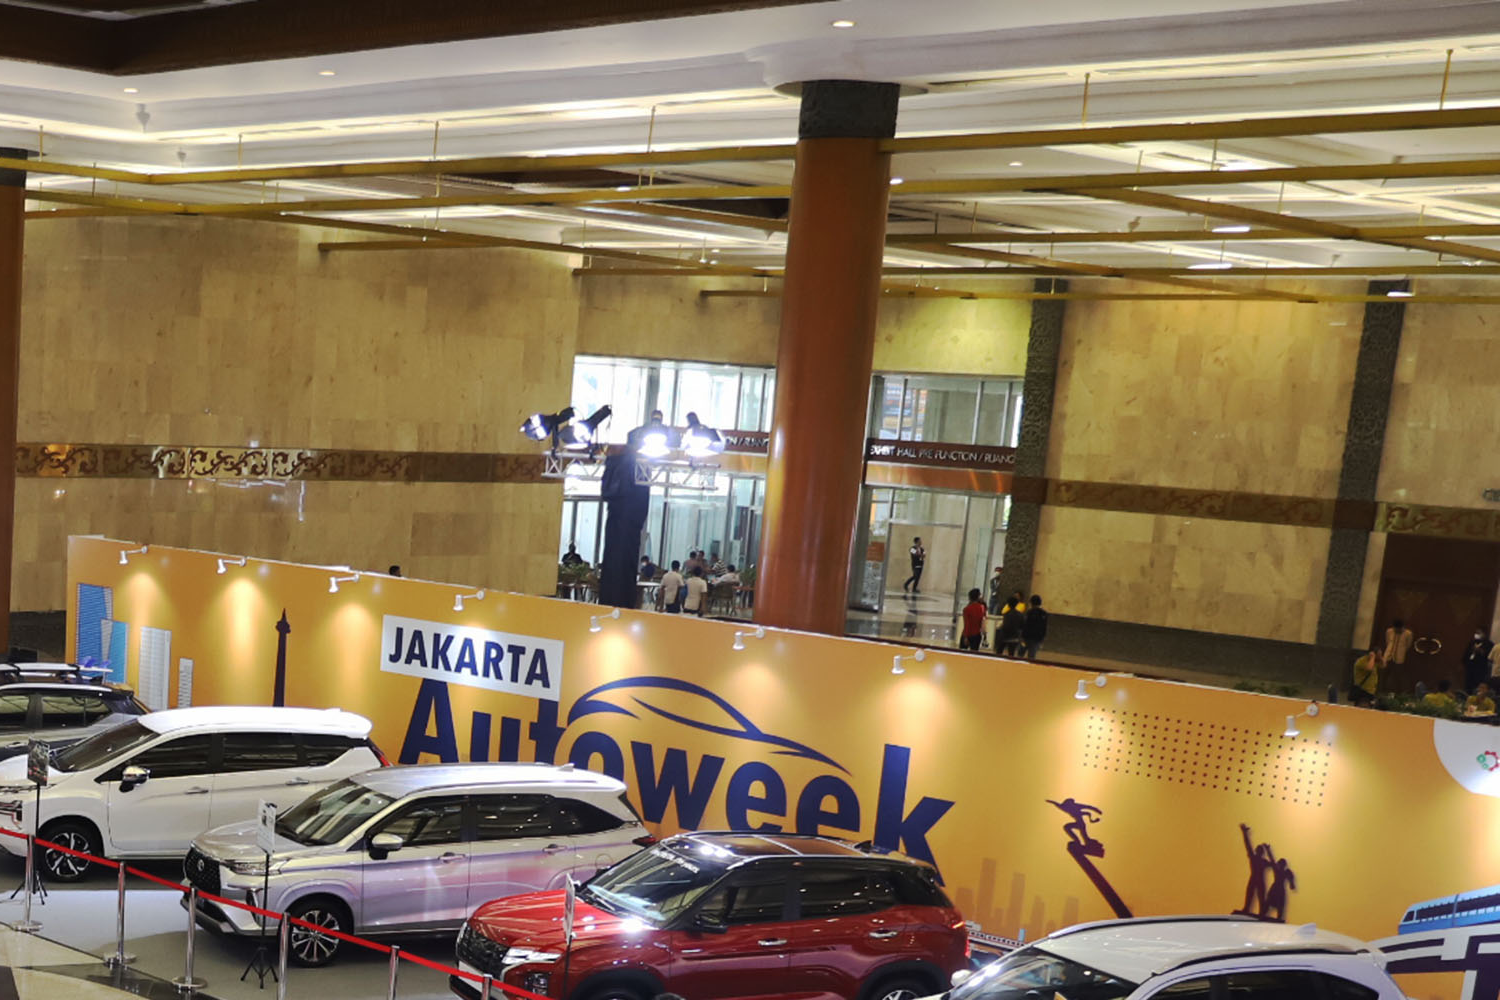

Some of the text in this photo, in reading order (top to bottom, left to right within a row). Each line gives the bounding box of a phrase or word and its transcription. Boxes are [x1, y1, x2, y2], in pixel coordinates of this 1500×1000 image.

[896, 447, 917, 458] HALL
[934, 450, 978, 462] FUNCTION
[389, 627, 552, 690] JAKARTA
[399, 677, 956, 887] Autoweek
